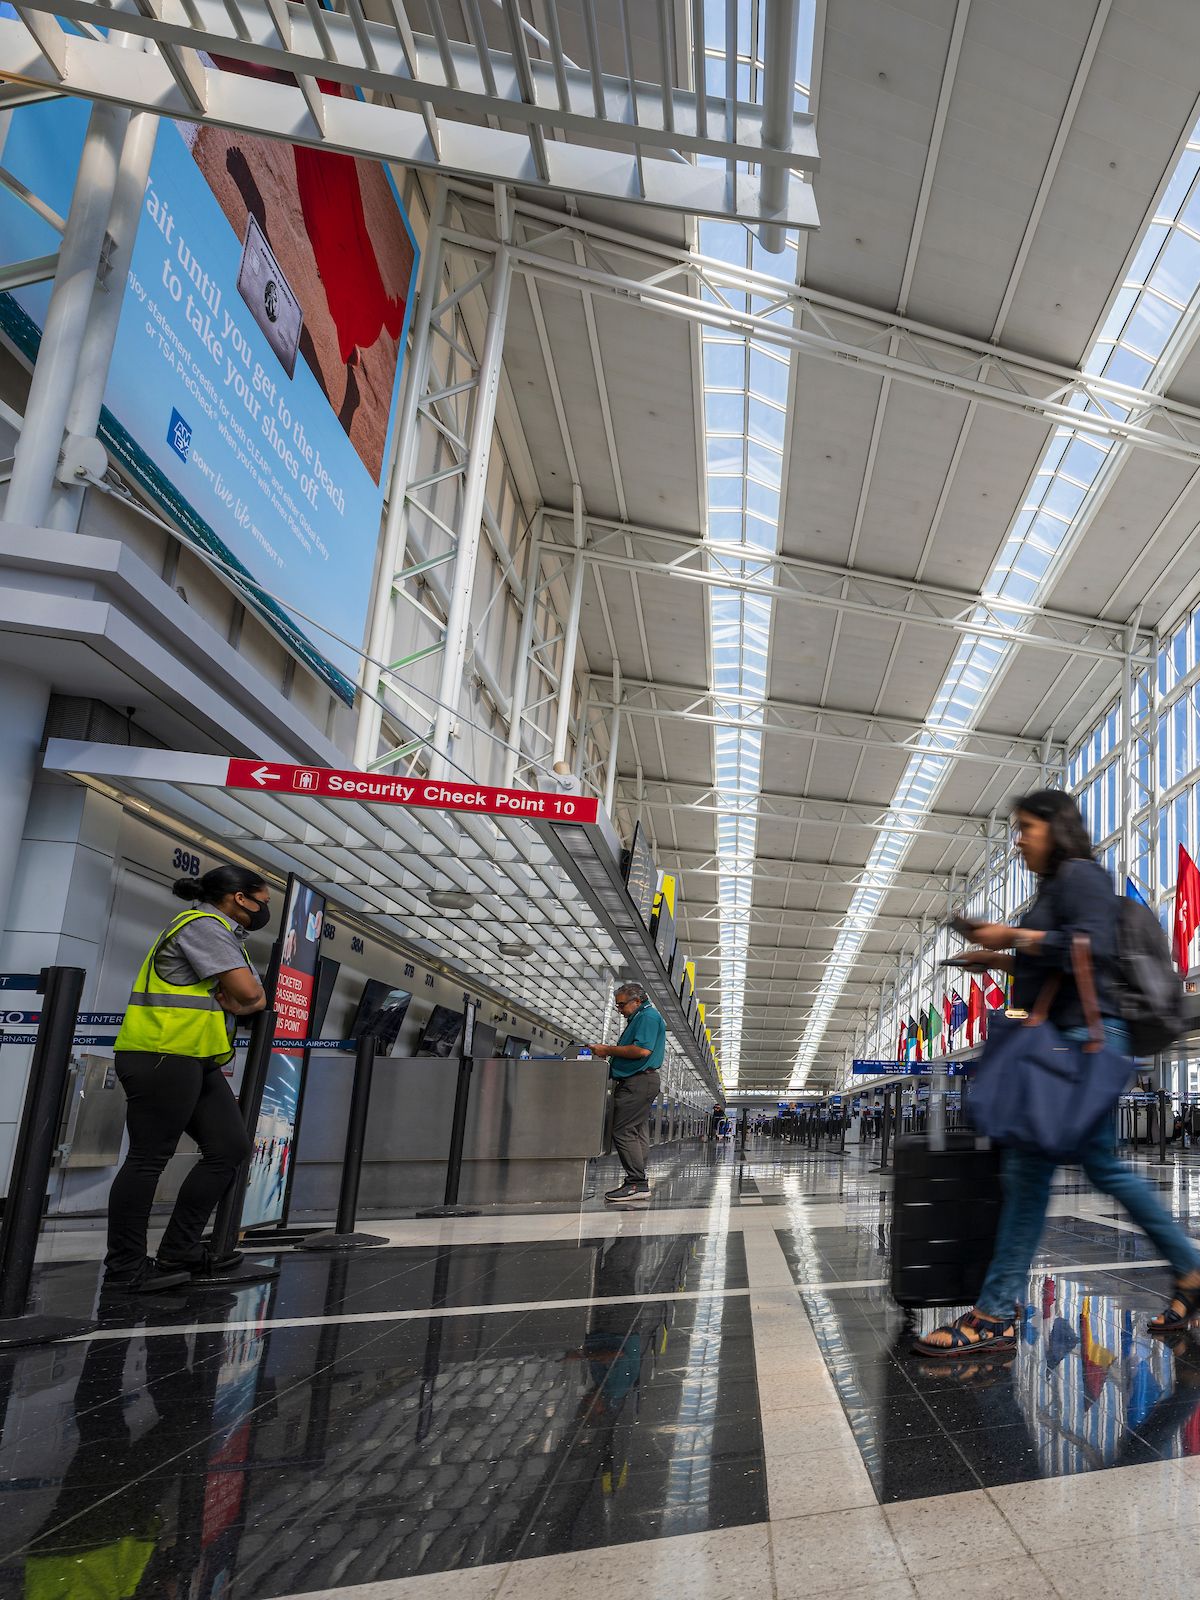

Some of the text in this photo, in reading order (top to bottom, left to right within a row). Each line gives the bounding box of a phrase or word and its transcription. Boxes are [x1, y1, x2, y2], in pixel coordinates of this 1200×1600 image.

[127, 271, 147, 303] njoy
[147, 300, 192, 366] statement
[192, 363, 218, 403] credits
[219, 399, 230, 418] for
[230, 415, 247, 443] both
[144, 176, 345, 516] ait until you get to the beach
[145, 321, 157, 338] or
[158, 333, 175, 367] TSA
[218, 421, 237, 451] when
[162, 259, 319, 511] to take your shoes off.
[327, 775, 575, 815] Security Check Point 10
[172, 848, 200, 876] 39B
[323, 922, 336, 940] 8B
[351, 936, 364, 955] 38A
[284, 1019, 300, 1032] POINT
[288, 1005, 309, 1021] BEYOND
